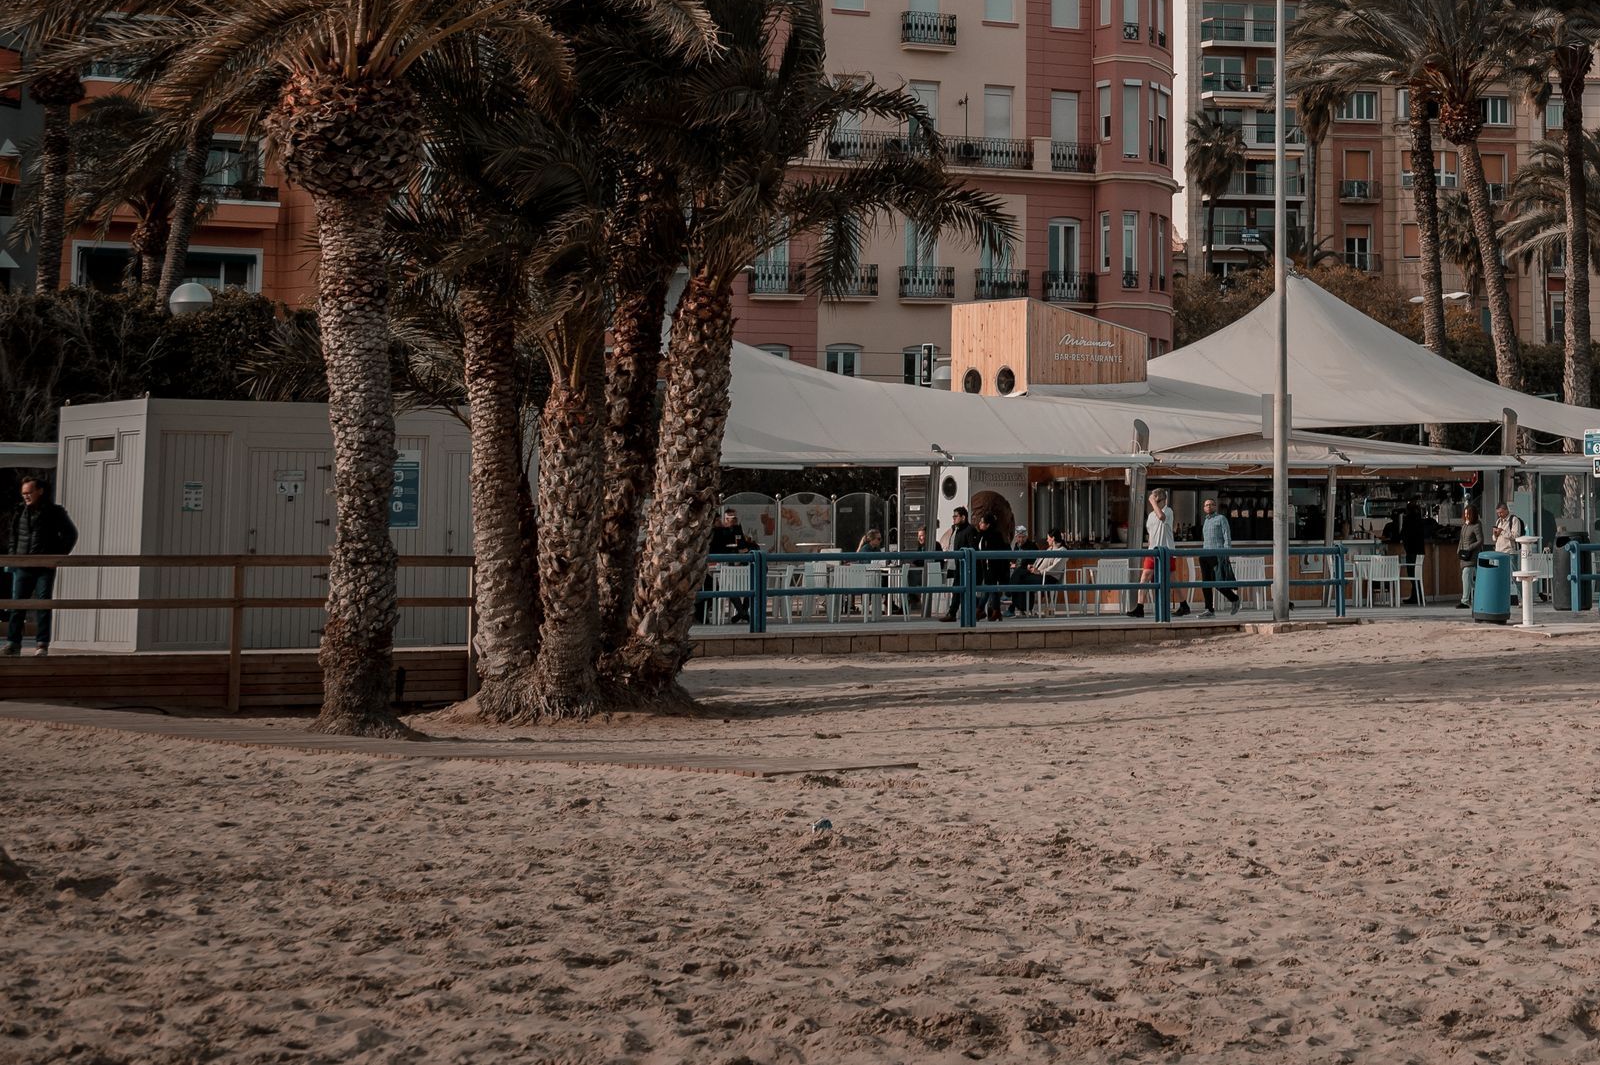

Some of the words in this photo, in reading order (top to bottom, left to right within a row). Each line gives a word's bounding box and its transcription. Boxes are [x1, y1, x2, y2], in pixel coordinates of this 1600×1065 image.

[1059, 333, 1115, 348] Miramar
[1054, 352, 1123, 363] BAR-RESTAURANTE
[1595, 444, 1600, 453] 3
